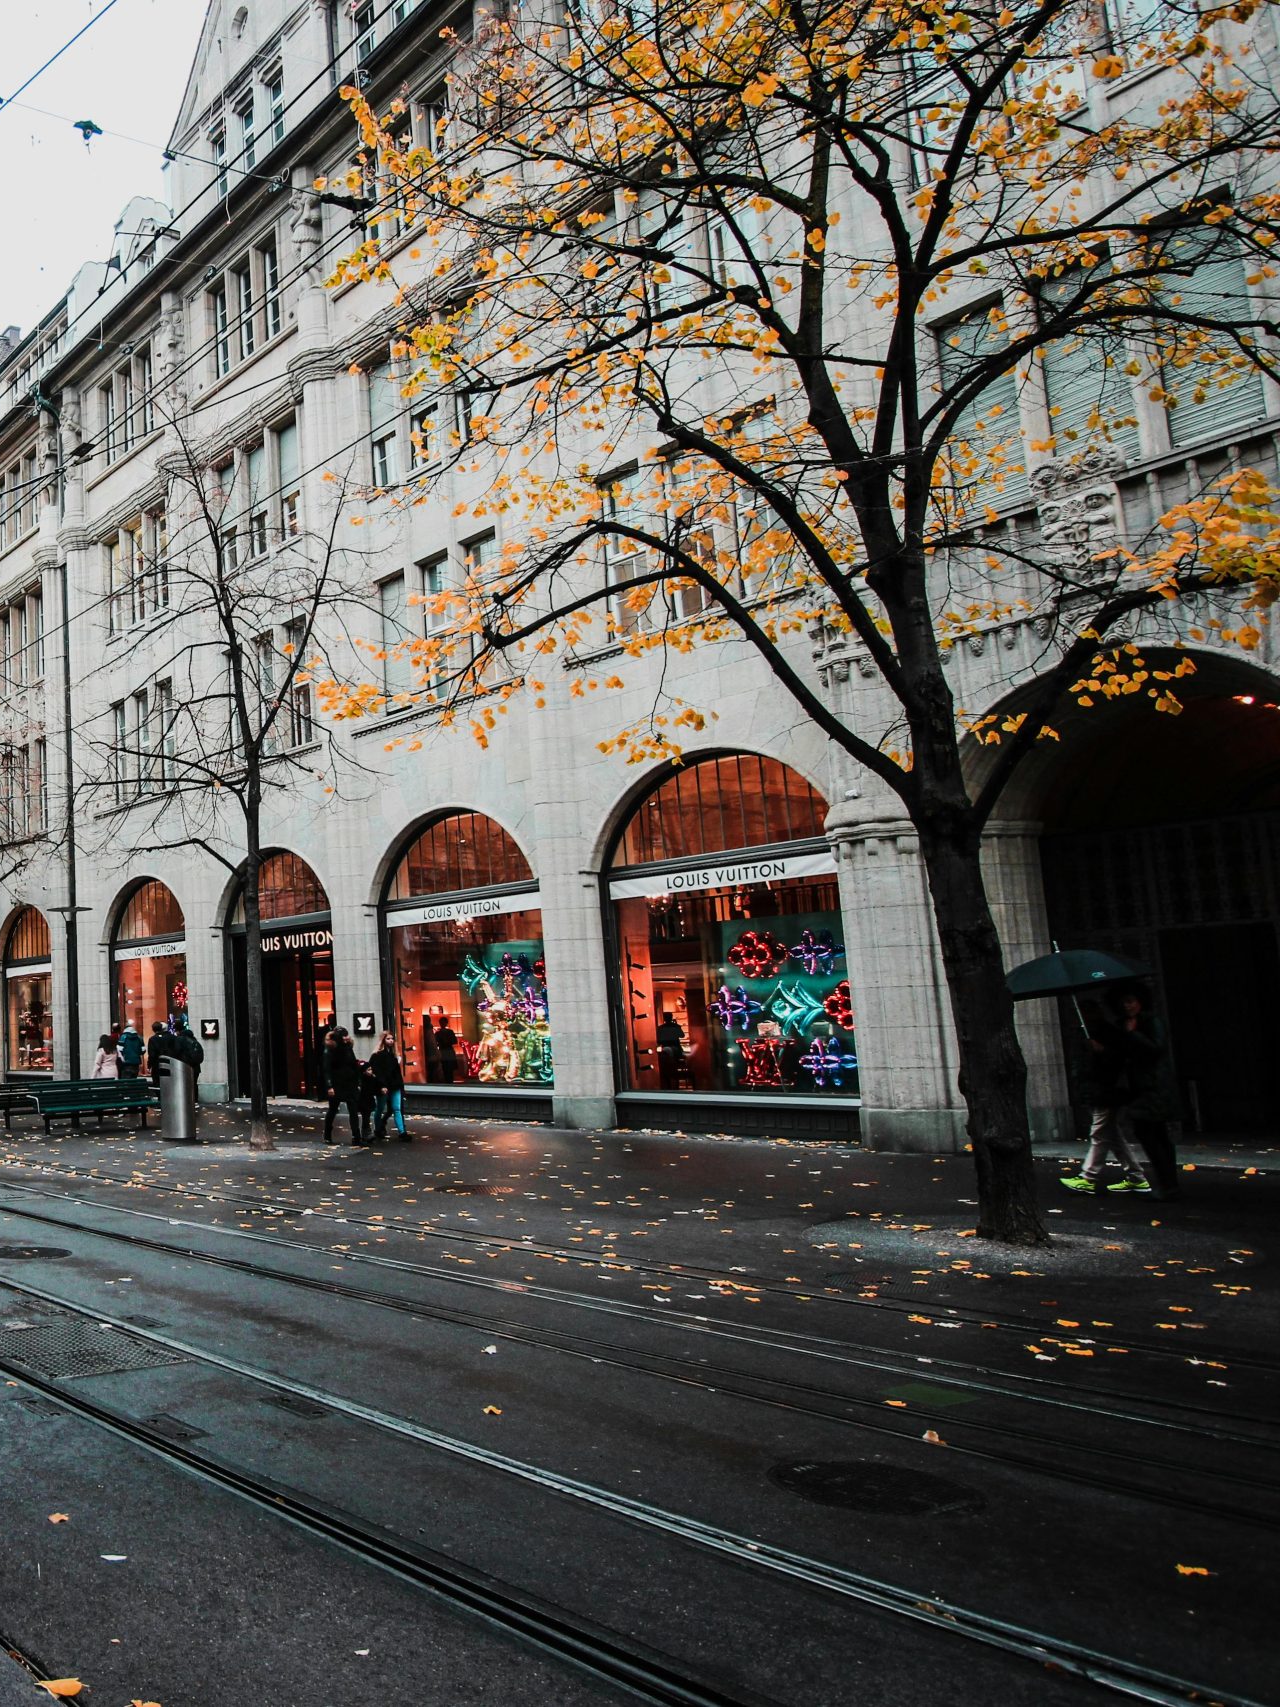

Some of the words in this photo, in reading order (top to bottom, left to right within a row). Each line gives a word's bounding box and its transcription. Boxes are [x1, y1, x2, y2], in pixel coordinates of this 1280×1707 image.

[666, 872, 710, 889] LOUIS
[715, 862, 785, 883] VUITTON
[423, 906, 452, 920] LOUIS
[455, 900, 500, 915] VUITTON
[134, 945, 151, 957] LOUIS
[151, 944, 176, 955] VUITTON
[260, 936, 281, 952] UIS
[282, 931, 334, 950] VUITTON
